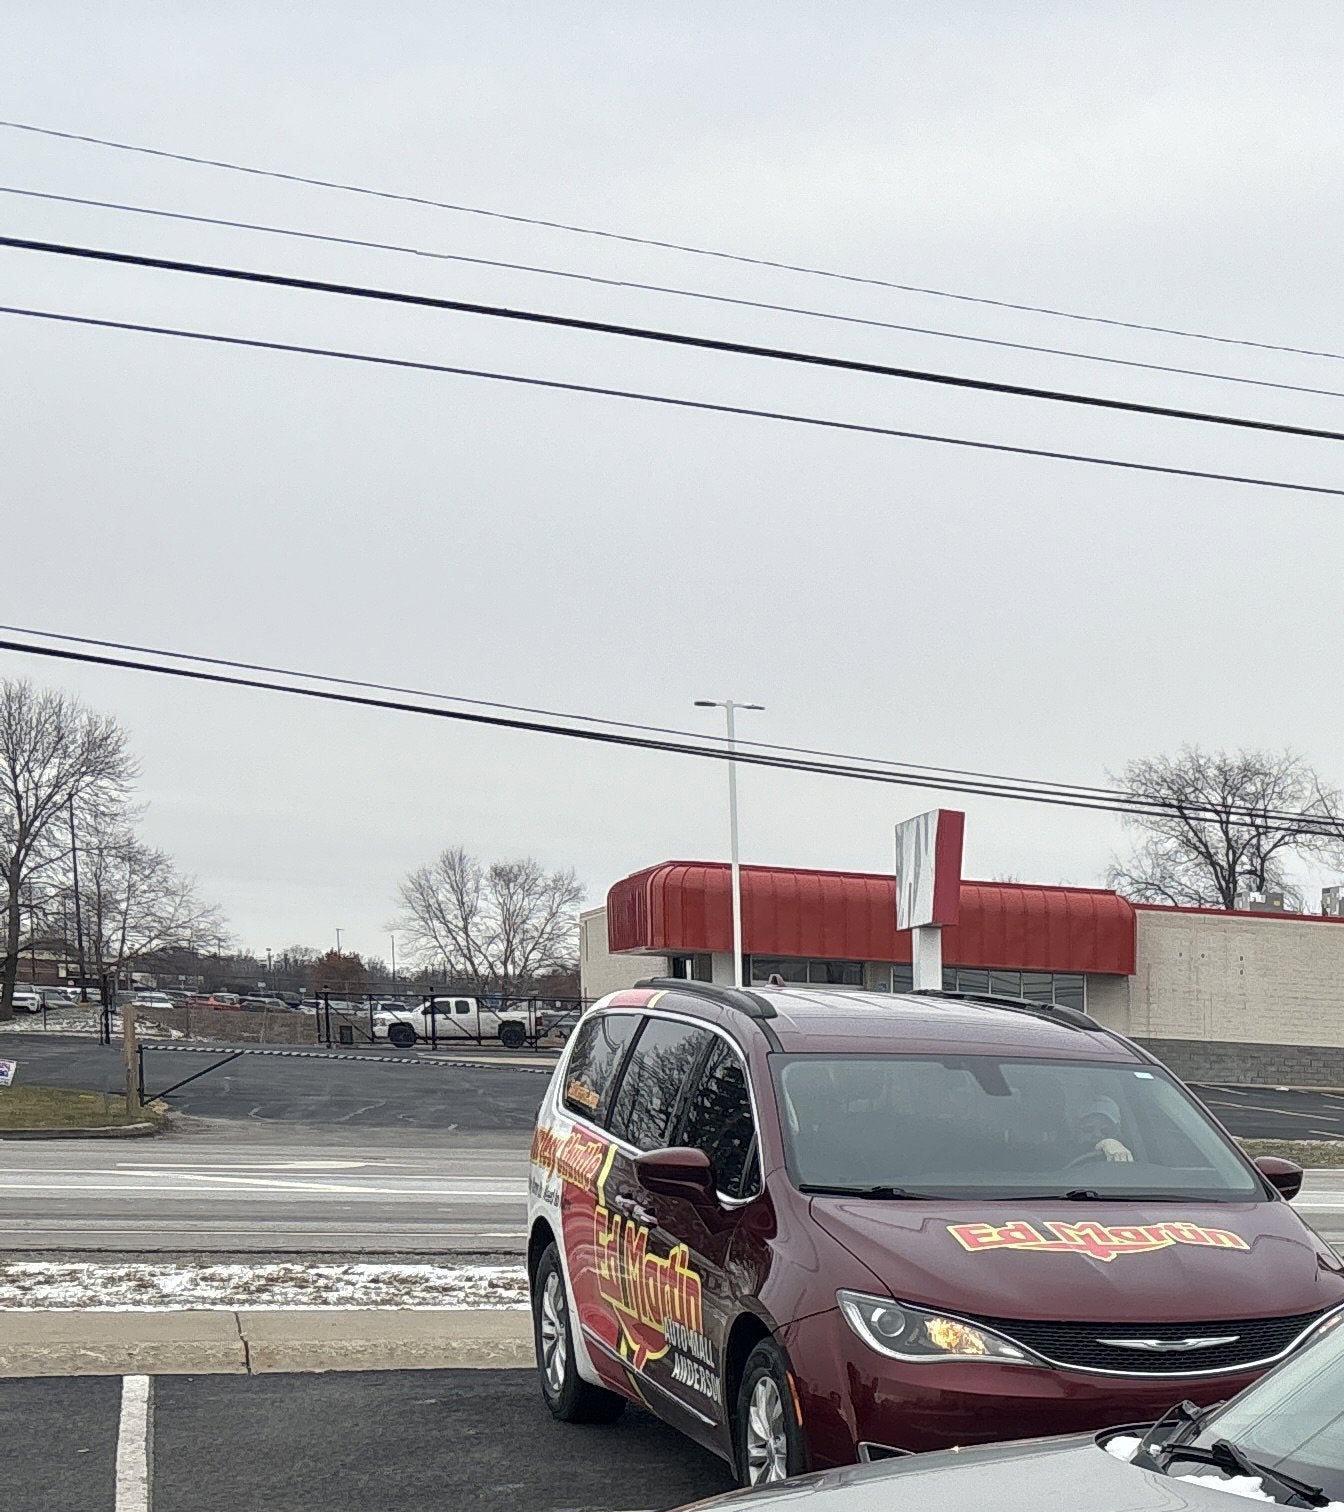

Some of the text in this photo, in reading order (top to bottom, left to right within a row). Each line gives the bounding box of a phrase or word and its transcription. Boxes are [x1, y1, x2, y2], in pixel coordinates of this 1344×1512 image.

[594, 1205, 704, 1336] Ed Martin
[947, 1221, 1251, 1261] Ed Martin
